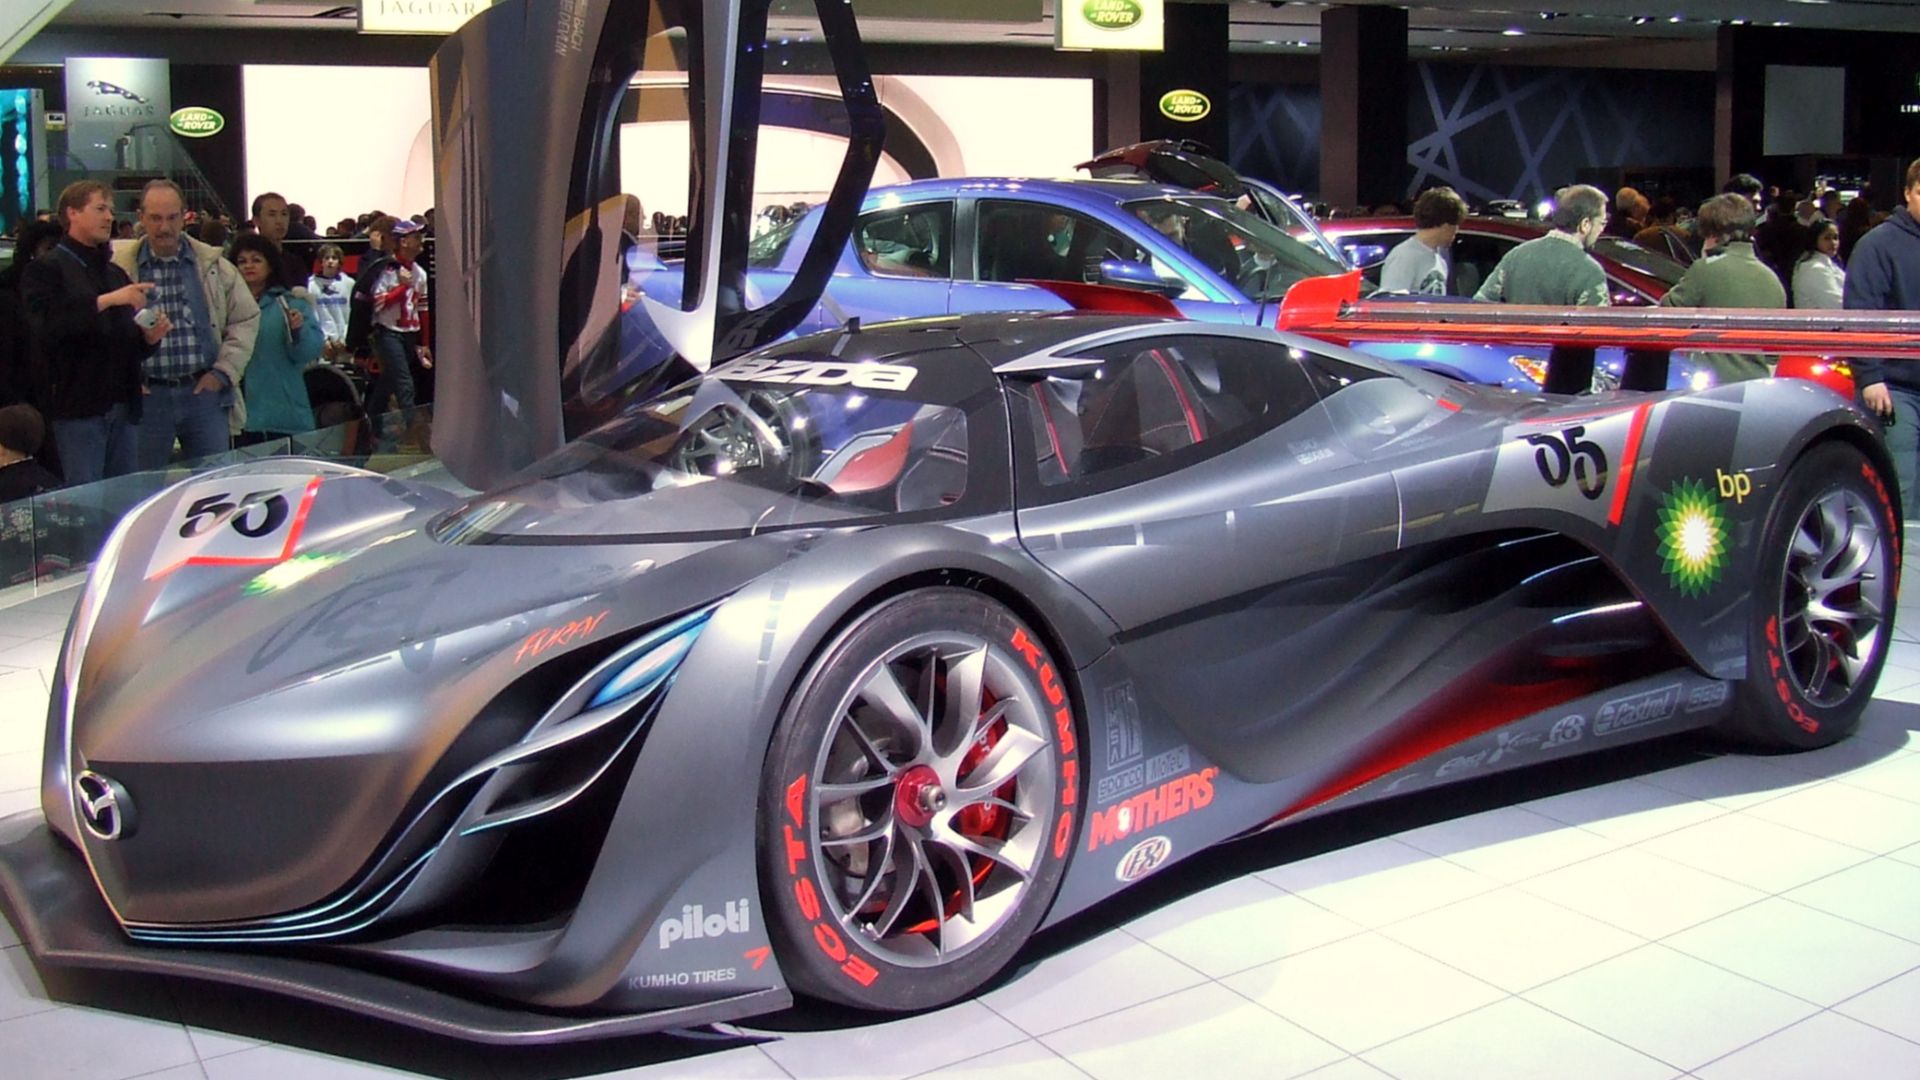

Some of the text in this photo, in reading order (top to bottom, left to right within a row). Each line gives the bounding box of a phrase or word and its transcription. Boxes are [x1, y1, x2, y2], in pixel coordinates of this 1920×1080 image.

[378, 0, 476, 16] JAGUAR
[83, 105, 155, 118] JAGUAR
[1716, 468, 1751, 503] bp
[179, 487, 289, 538] 55
[1011, 627, 1075, 859] KUMHO
[784, 773, 880, 987] ECSTA
[659, 898, 749, 949] piloti
[628, 967, 737, 990] KUMHO TIRES
